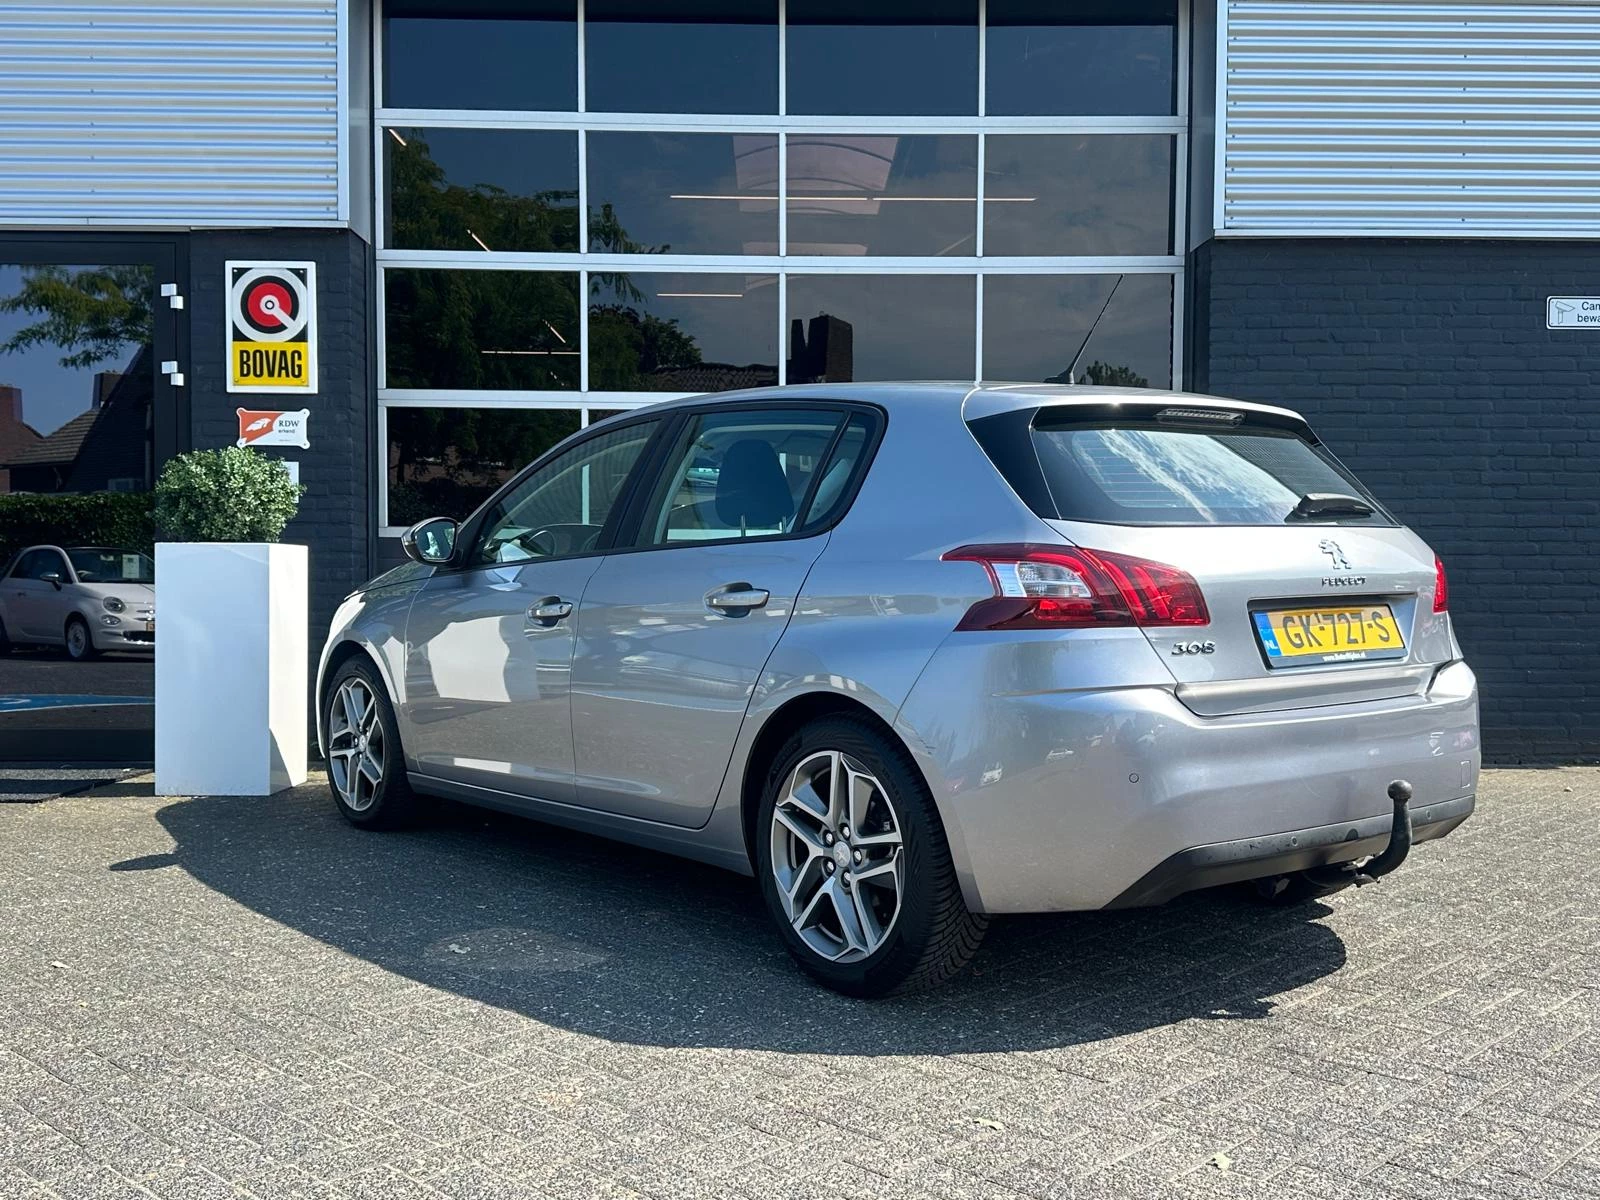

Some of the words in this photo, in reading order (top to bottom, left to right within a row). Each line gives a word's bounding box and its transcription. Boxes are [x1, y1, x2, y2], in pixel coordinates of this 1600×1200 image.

[239, 349, 302, 378] BOVAG
[278, 419, 300, 428] RDW
[1321, 576, 1367, 587] PEUGEOT
[1282, 611, 1390, 648] GK-727-S
[1171, 640, 1216, 656] 308
[1265, 639, 1278, 649] NL
